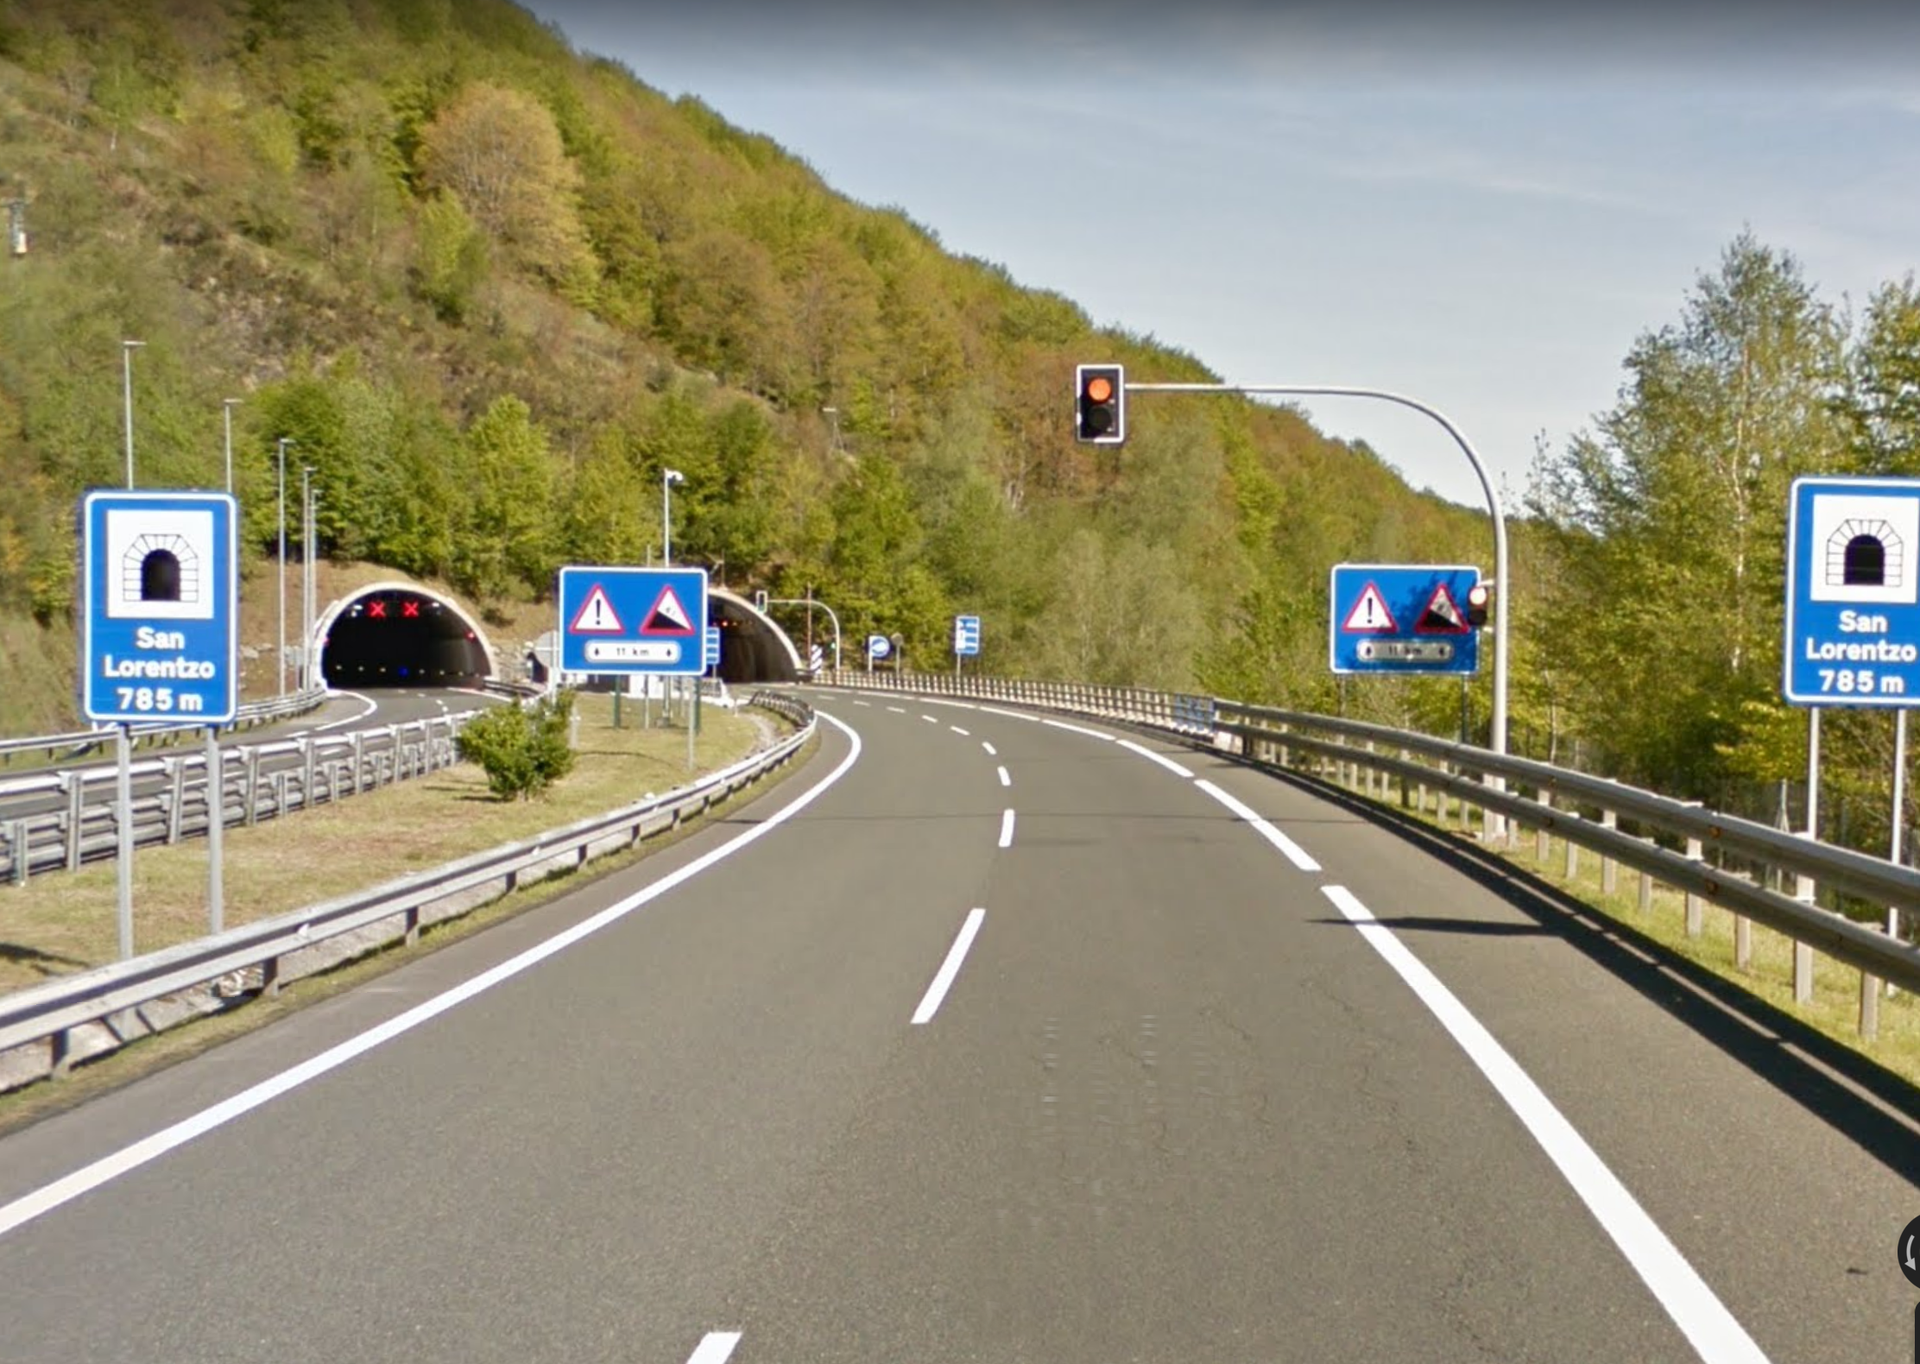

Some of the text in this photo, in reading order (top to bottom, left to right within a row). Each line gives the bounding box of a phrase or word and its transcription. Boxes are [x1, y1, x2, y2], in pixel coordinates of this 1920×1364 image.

[1838, 609, 1888, 633] San
[135, 626, 186, 649] San
[1806, 637, 1917, 662] Lorentzo
[616, 647, 650, 656] 11 km
[104, 654, 216, 679] Lorentzo
[1818, 669, 1905, 694] 785 m
[117, 687, 204, 712] 785 m
